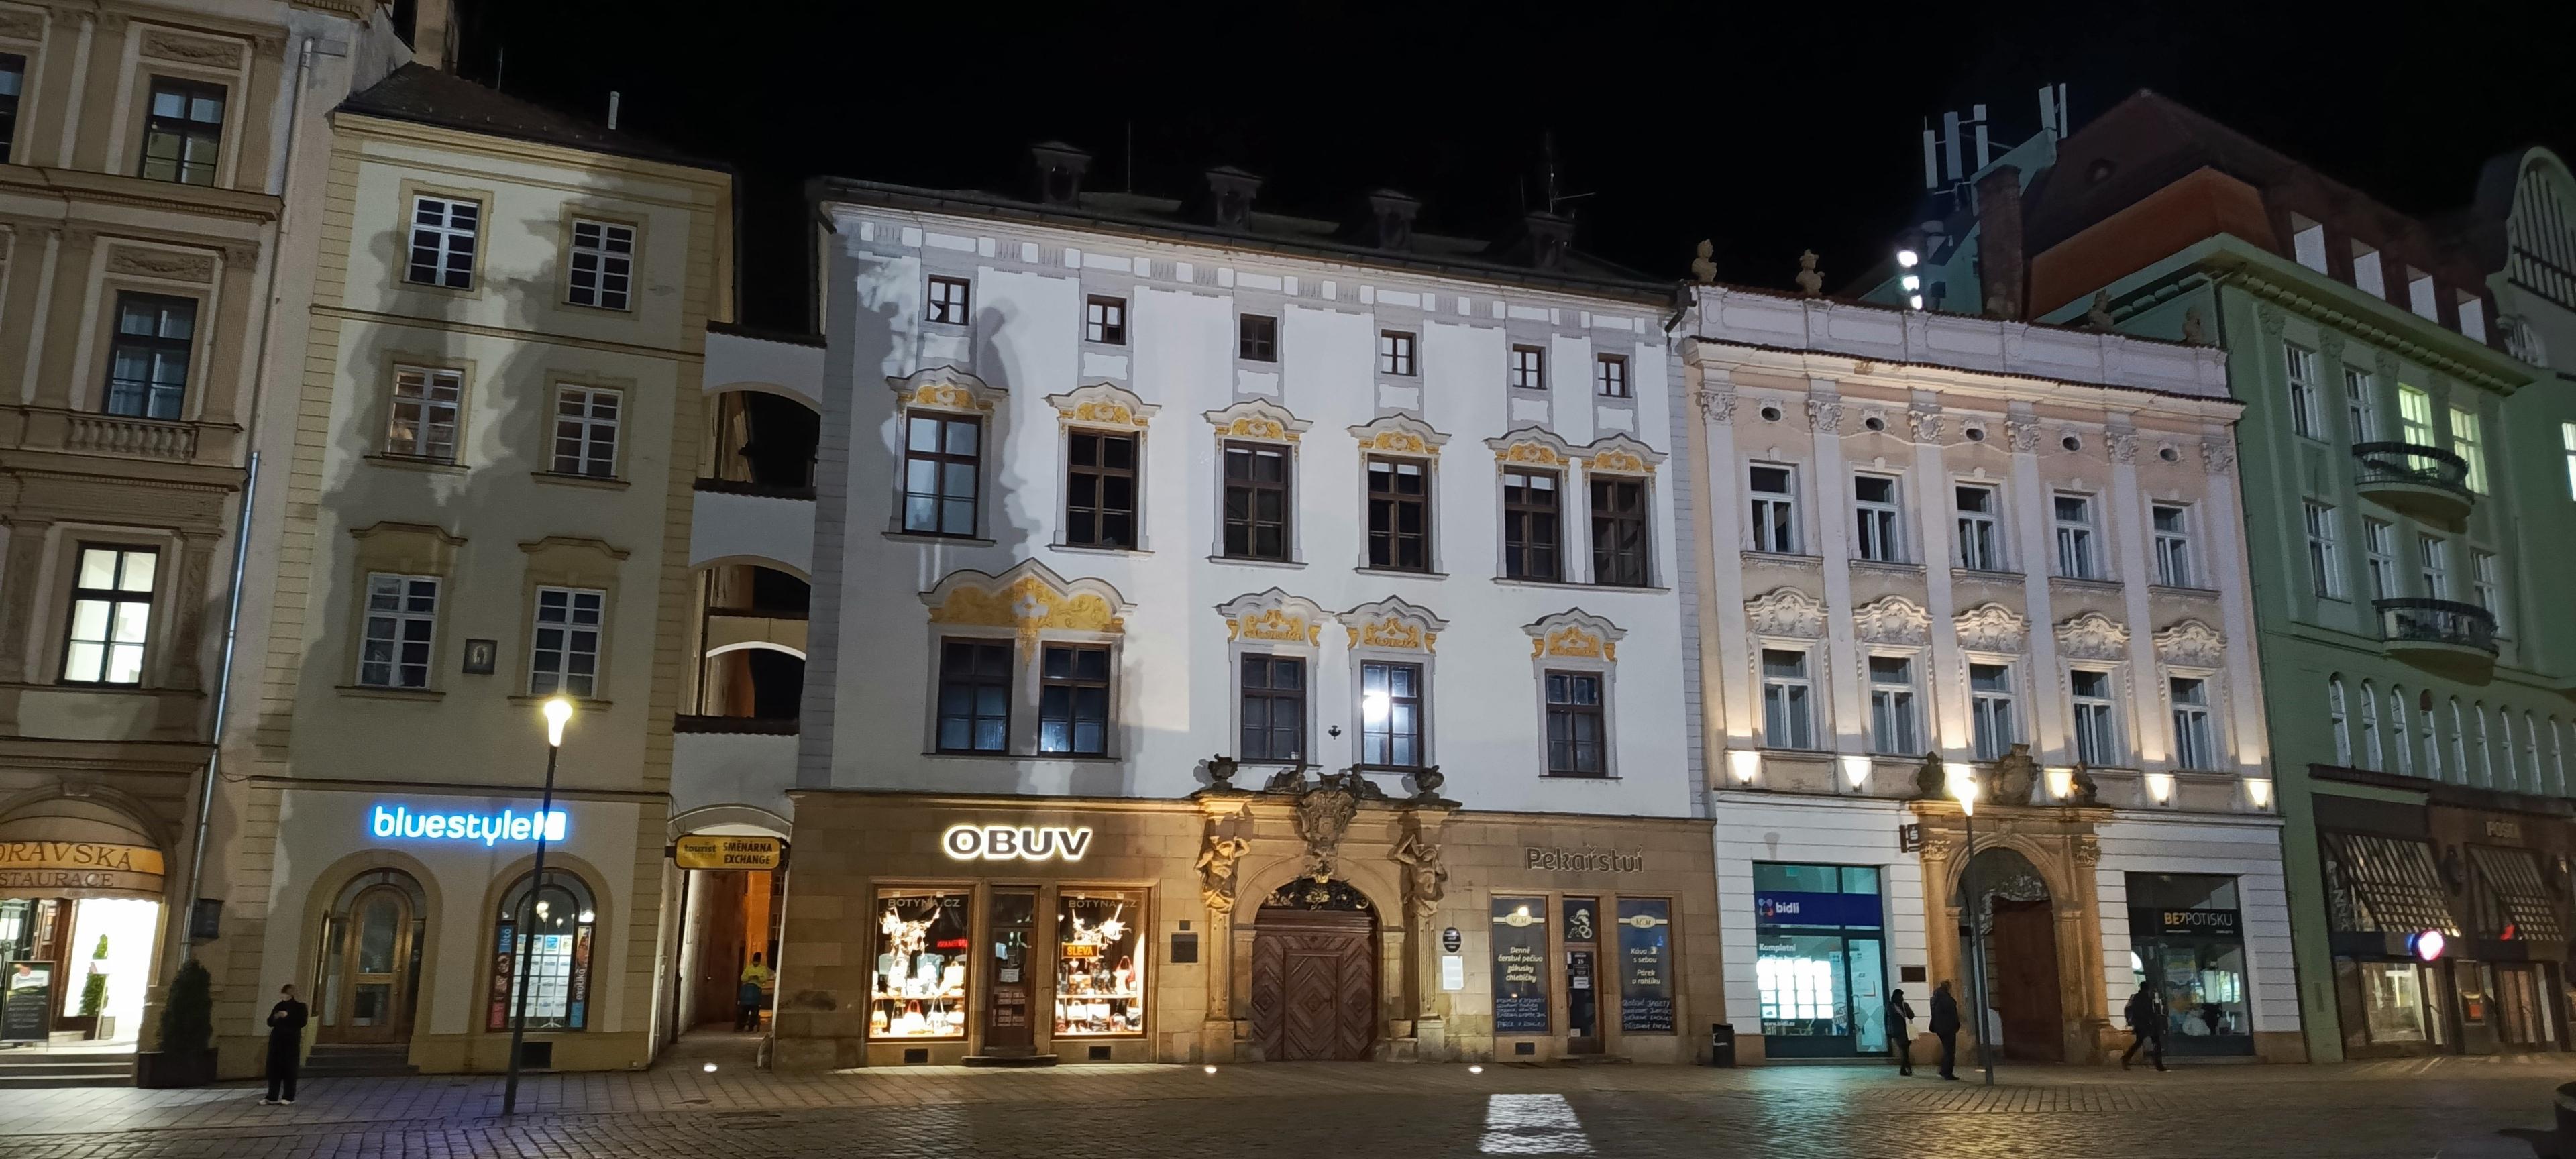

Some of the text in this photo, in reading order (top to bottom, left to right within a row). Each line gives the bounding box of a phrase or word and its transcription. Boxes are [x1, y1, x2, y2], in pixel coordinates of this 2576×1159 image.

[374, 806, 531, 846] bluestyle
[684, 842, 716, 853] tourist
[722, 840, 773, 852] SMĚNÁRNA
[945, 826, 1091, 859] OBUV
[724, 854, 771, 865] EXCHANGE
[1525, 844, 1644, 873] Pekařství
[888, 899, 961, 907] BOTYNA.CZ
[1068, 899, 1138, 908] BOTYNACZ
[1776, 902, 1800, 914] bidli
[1067, 946, 1093, 956] SLEVA
